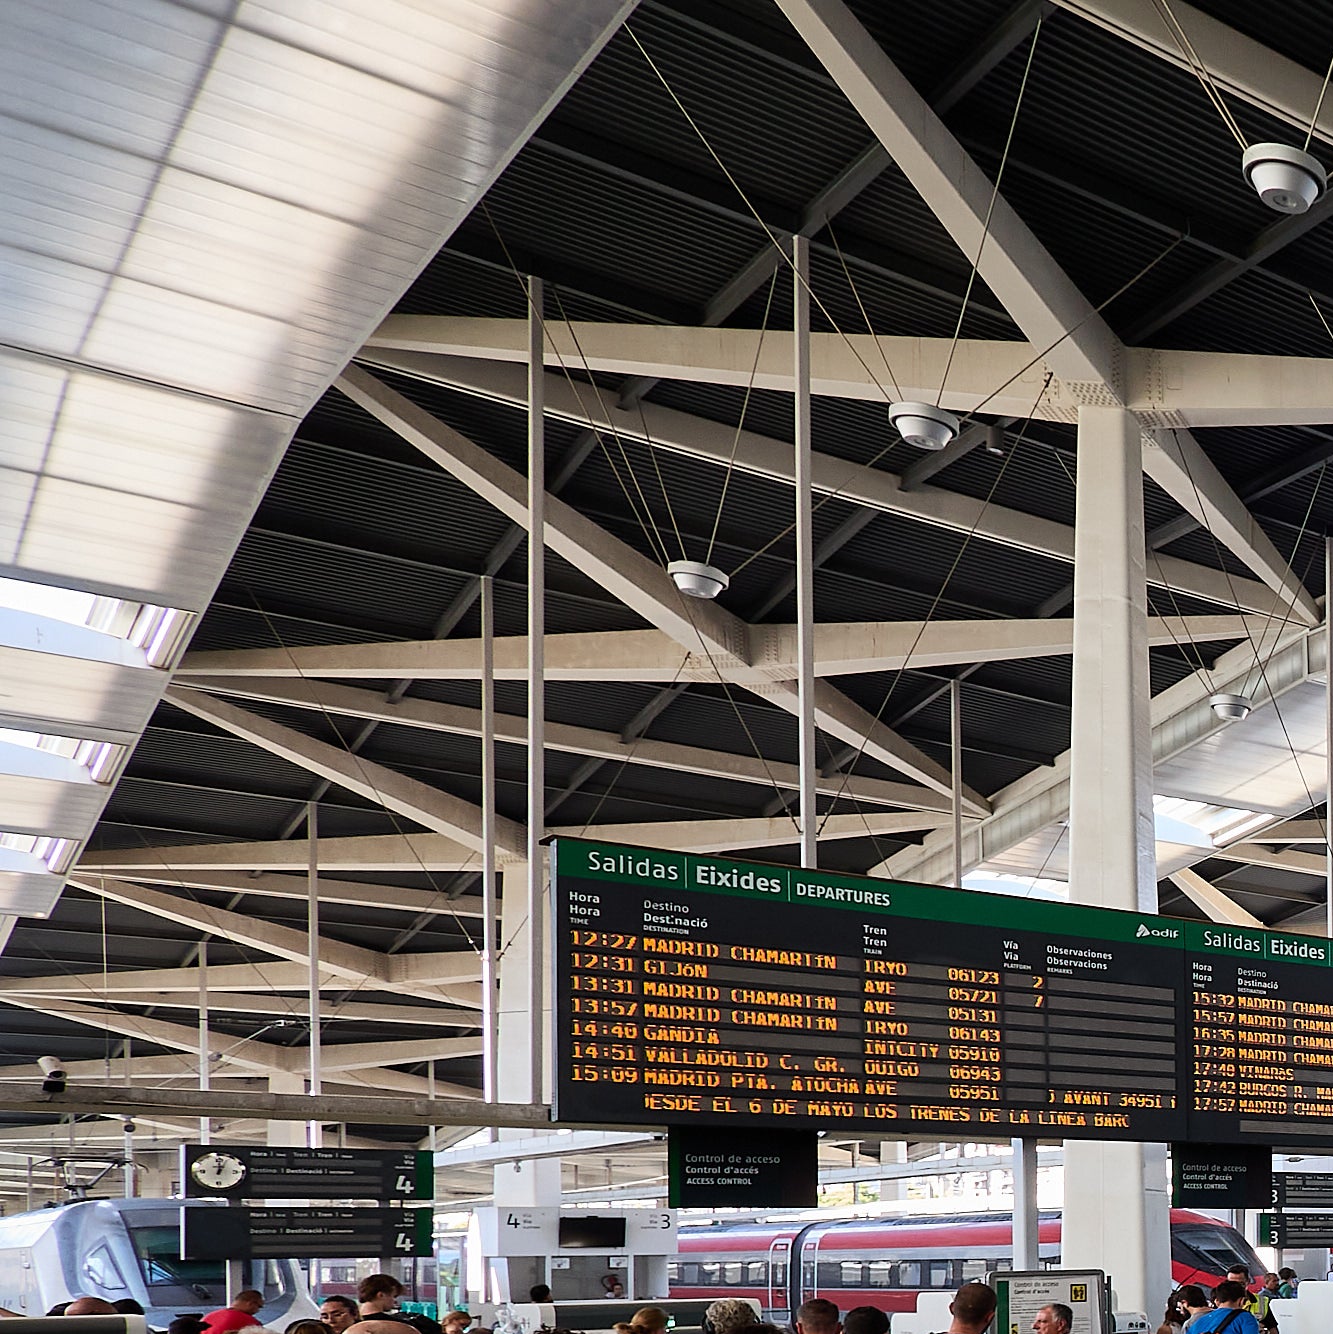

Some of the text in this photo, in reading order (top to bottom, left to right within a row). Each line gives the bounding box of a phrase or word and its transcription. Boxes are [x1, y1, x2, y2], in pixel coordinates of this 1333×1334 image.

[588, 852, 679, 880] Salidas
[696, 866, 781, 893] Eixides
[569, 891, 600, 904] Hora
[796, 882, 891, 907] DEPARTURES
[569, 904, 600, 917] Hora
[643, 899, 690, 914] Destino
[643, 913, 708, 929] Destinació
[863, 924, 887, 936] Tren
[1150, 928, 1180, 939] adif
[863, 936, 887, 948] Tren
[1003, 940, 1019, 951] Vía
[1204, 930, 1261, 952] Salidas
[1003, 951, 1019, 962] Via
[1046, 944, 1113, 961] Observaciones
[1270, 939, 1326, 960] Eixides
[570, 929, 637, 950] 12:27
[643, 936, 719, 958] MADRID
[864, 959, 908, 976] IRYO
[948, 968, 999, 985] 06123
[1032, 976, 1043, 989] 2
[1046, 956, 1108, 971] Observacions
[570, 952, 635, 972] 12:31
[863, 981, 896, 995] AVE
[570, 975, 635, 994] 13:31
[643, 982, 720, 1001] MADRID
[863, 1001, 896, 1015] AVE
[948, 1007, 998, 1024] 05131
[1192, 991, 1235, 1008] 15:32
[570, 998, 637, 1016] 13:57
[644, 1003, 720, 1022] MADRID
[865, 1020, 909, 1036] IRYO
[949, 1026, 1001, 1043] 06143
[1192, 1009, 1236, 1025] 15:57
[571, 1019, 638, 1039] 14:40
[644, 1024, 720, 1045] GANDIA
[948, 1046, 1001, 1062] 05910
[1192, 1026, 1236, 1042] 16:35
[1193, 1044, 1236, 1060] 17:28
[571, 1041, 1001, 1082] 14:51 VALLADOLID C. GR. OUIGO 06943
[1193, 1061, 1236, 1077] 17:40
[571, 1064, 1162, 1109] 15:09 MADRID PTA. ATOCHA AVE 05951 AVANT 34951
[1193, 1079, 1237, 1095] 17:42
[712, 1096, 738, 1113] EL
[749, 1098, 762, 1114] 6
[772, 1098, 798, 1115] DE
[807, 1100, 854, 1117] MAYO
[863, 1102, 898, 1119] LOS
[909, 1104, 971, 1122] TRENES
[979, 1107, 1001, 1123] DE
[1009, 1108, 1031, 1124] LA
[1038, 1110, 1087, 1126] LINEA
[1193, 1096, 1237, 1112] 17:57
[685, 1152, 781, 1165] Control de acceso
[685, 1165, 721, 1175] Control
[395, 1174, 415, 1194] 4
[686, 1177, 752, 1186] ACCESS CONTROL
[506, 1213, 521, 1230] 4
[660, 1213, 671, 1230] 3
[395, 1232, 415, 1252] 4
[1270, 1231, 1279, 1245] 3
